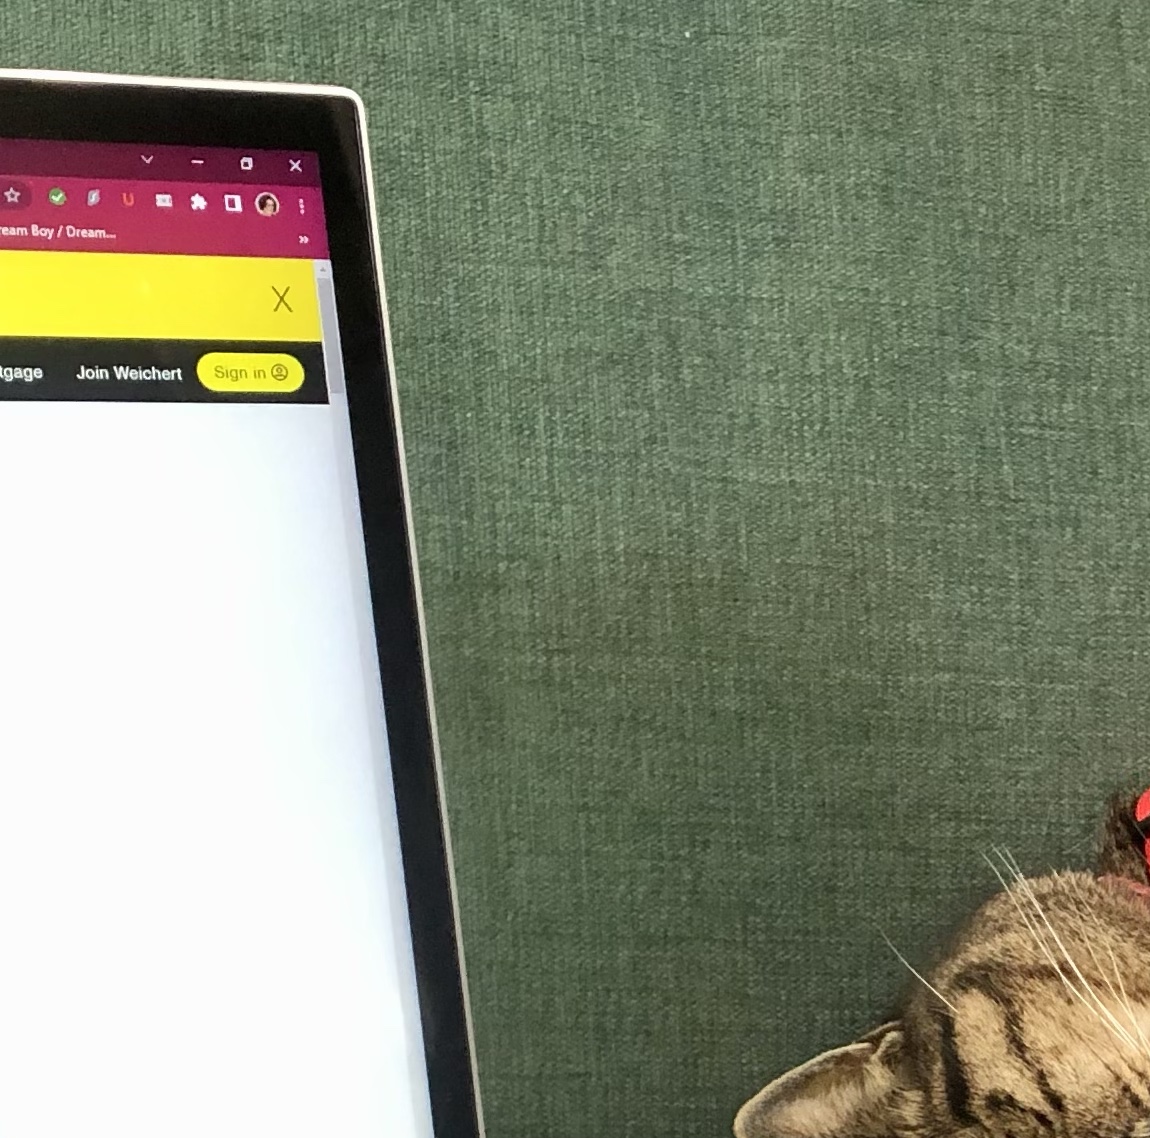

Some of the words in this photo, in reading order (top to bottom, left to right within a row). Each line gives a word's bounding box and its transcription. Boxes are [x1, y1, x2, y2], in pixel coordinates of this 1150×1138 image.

[31, 224, 54, 240] Boy
[76, 365, 110, 381] Join
[113, 365, 183, 382] Weichert
[214, 365, 248, 383] Sign
[252, 366, 267, 380] in
